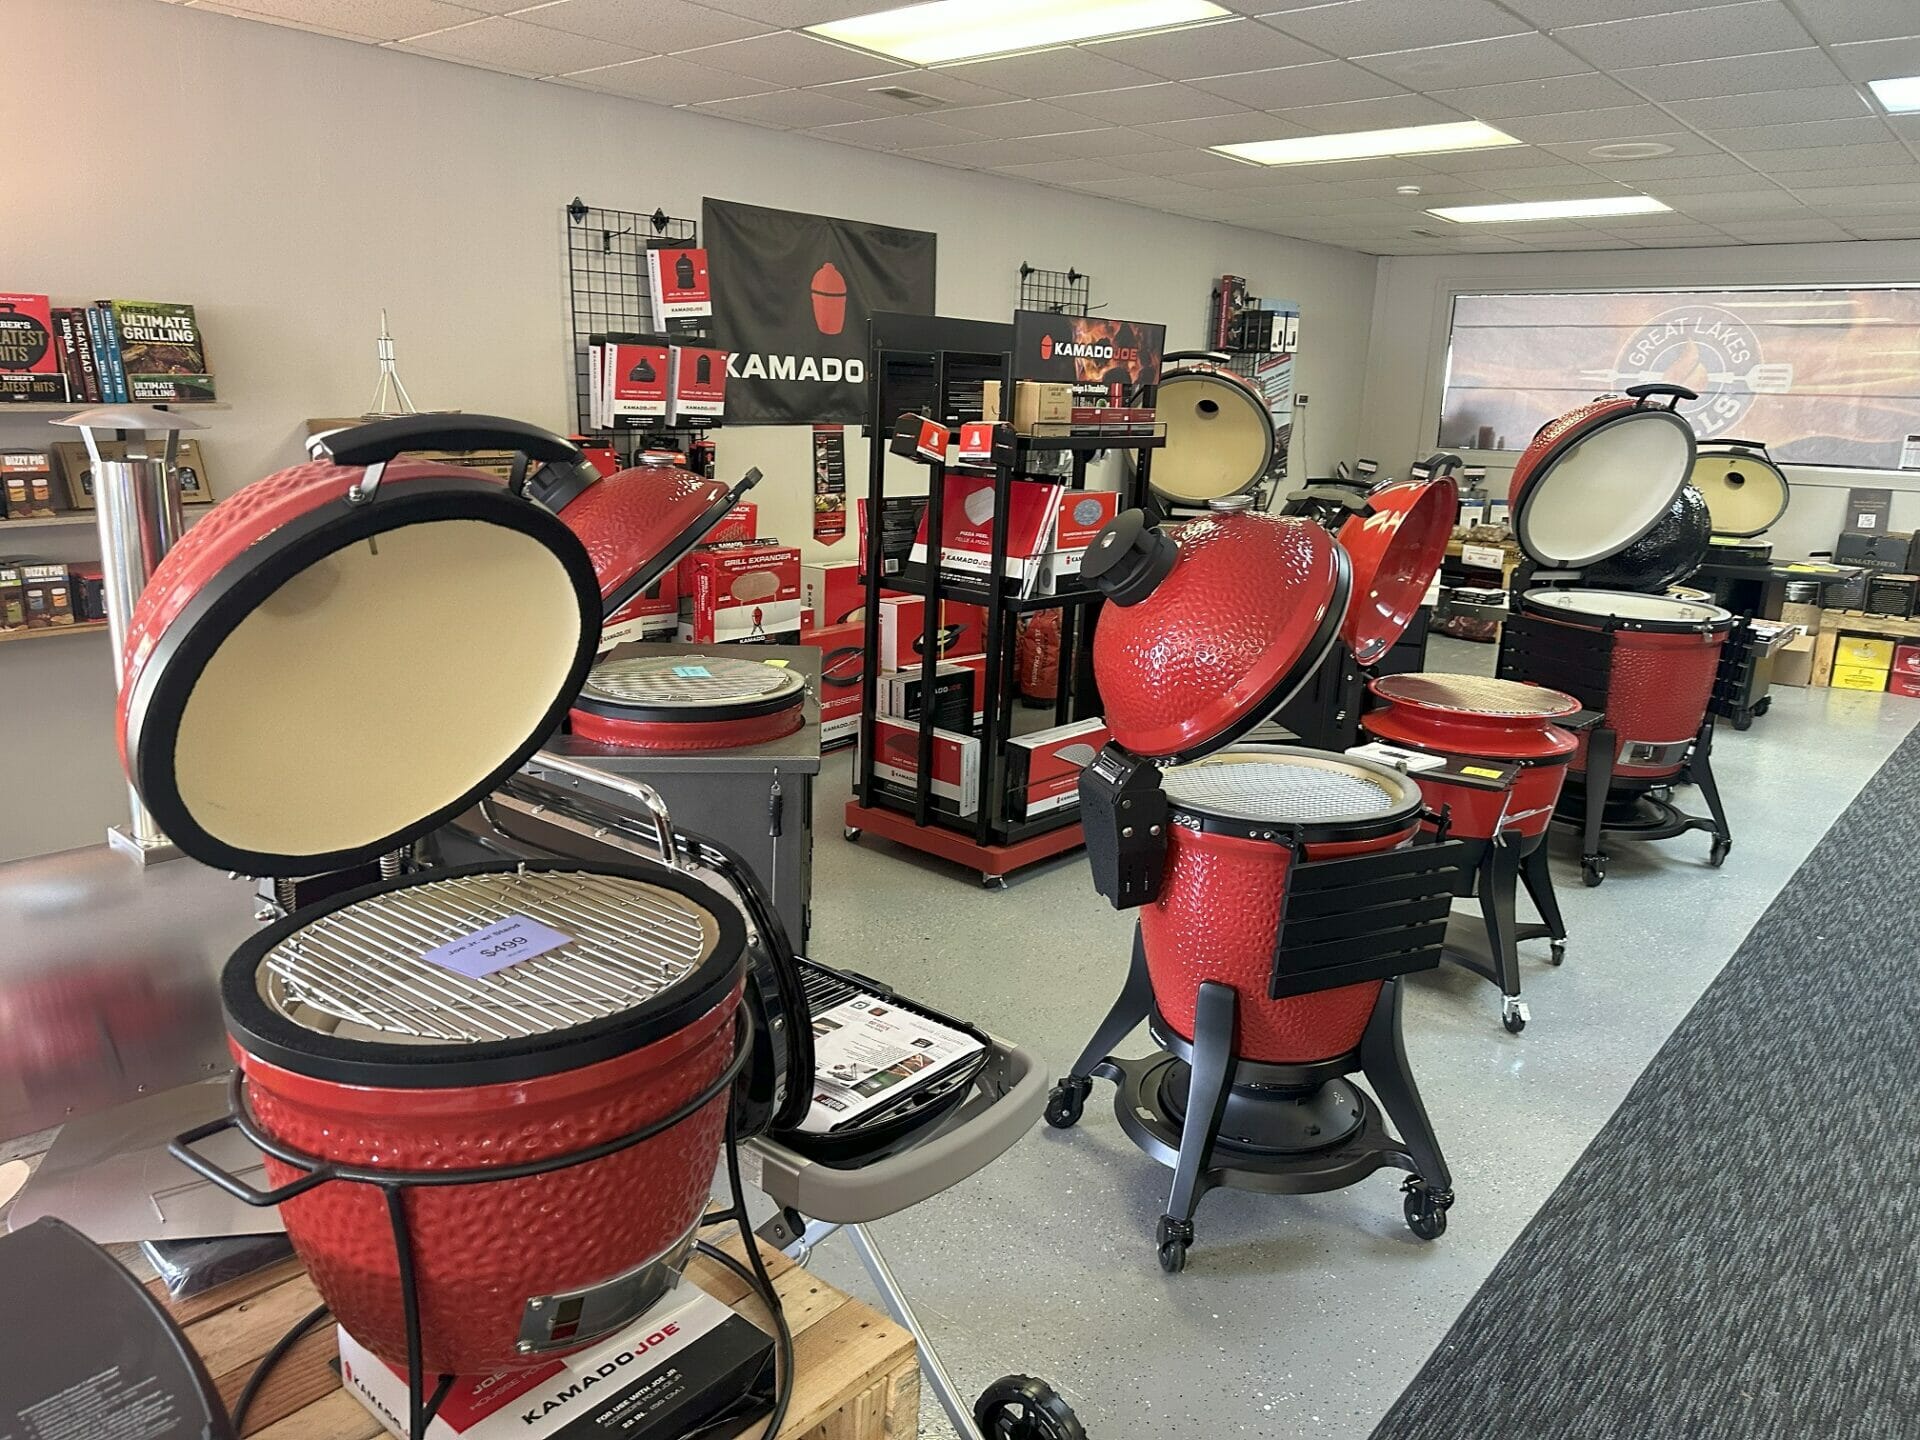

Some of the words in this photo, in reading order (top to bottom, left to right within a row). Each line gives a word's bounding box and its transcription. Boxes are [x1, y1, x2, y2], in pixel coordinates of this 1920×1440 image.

[0, 321, 32, 329] BER'S
[121, 313, 192, 330] ULTIMATE
[0, 330, 46, 346] ATEST
[123, 327, 194, 343] GRILLING
[1628, 317, 1689, 367] GREAT
[1694, 316, 1750, 364] LAKES
[74, 322, 94, 373] MEATHEAD
[725, 352, 865, 384] KAMADO
[0, 382, 31, 393] EATEST
[134, 381, 175, 390] ULTIMATE
[135, 389, 176, 398] GRILLING
[4, 456, 28, 466] DIZZY
[29, 455, 45, 465] PIG
[724, 558, 747, 567] GRILL
[748, 553, 792, 564] EXPANDER
[1841, 557, 1897, 568] UNMATCHED
[48, 566, 64, 576] PIG
[480, 936, 528, 957] $499
[521, 1321, 681, 1425] KAMADOJOE
[596, 1410, 614, 1424] FOR
[612, 1399, 631, 1412] USE
[628, 1386, 652, 1401] WITH
[651, 1375, 666, 1388] JOE
